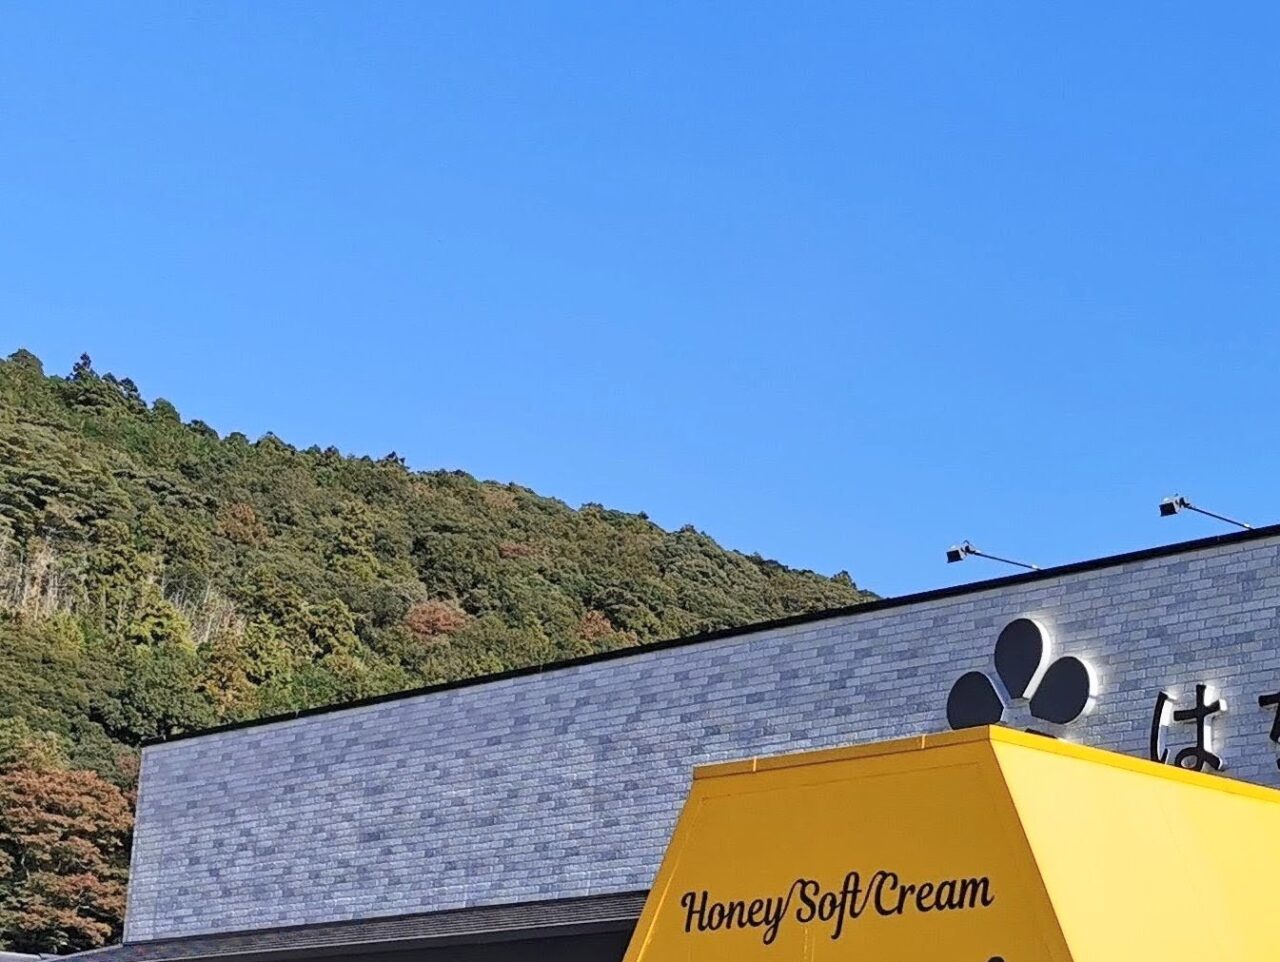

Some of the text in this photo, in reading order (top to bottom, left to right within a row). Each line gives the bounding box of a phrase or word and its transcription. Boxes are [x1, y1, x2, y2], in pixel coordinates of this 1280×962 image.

[681, 870, 995, 945] Honey Soft Cream
